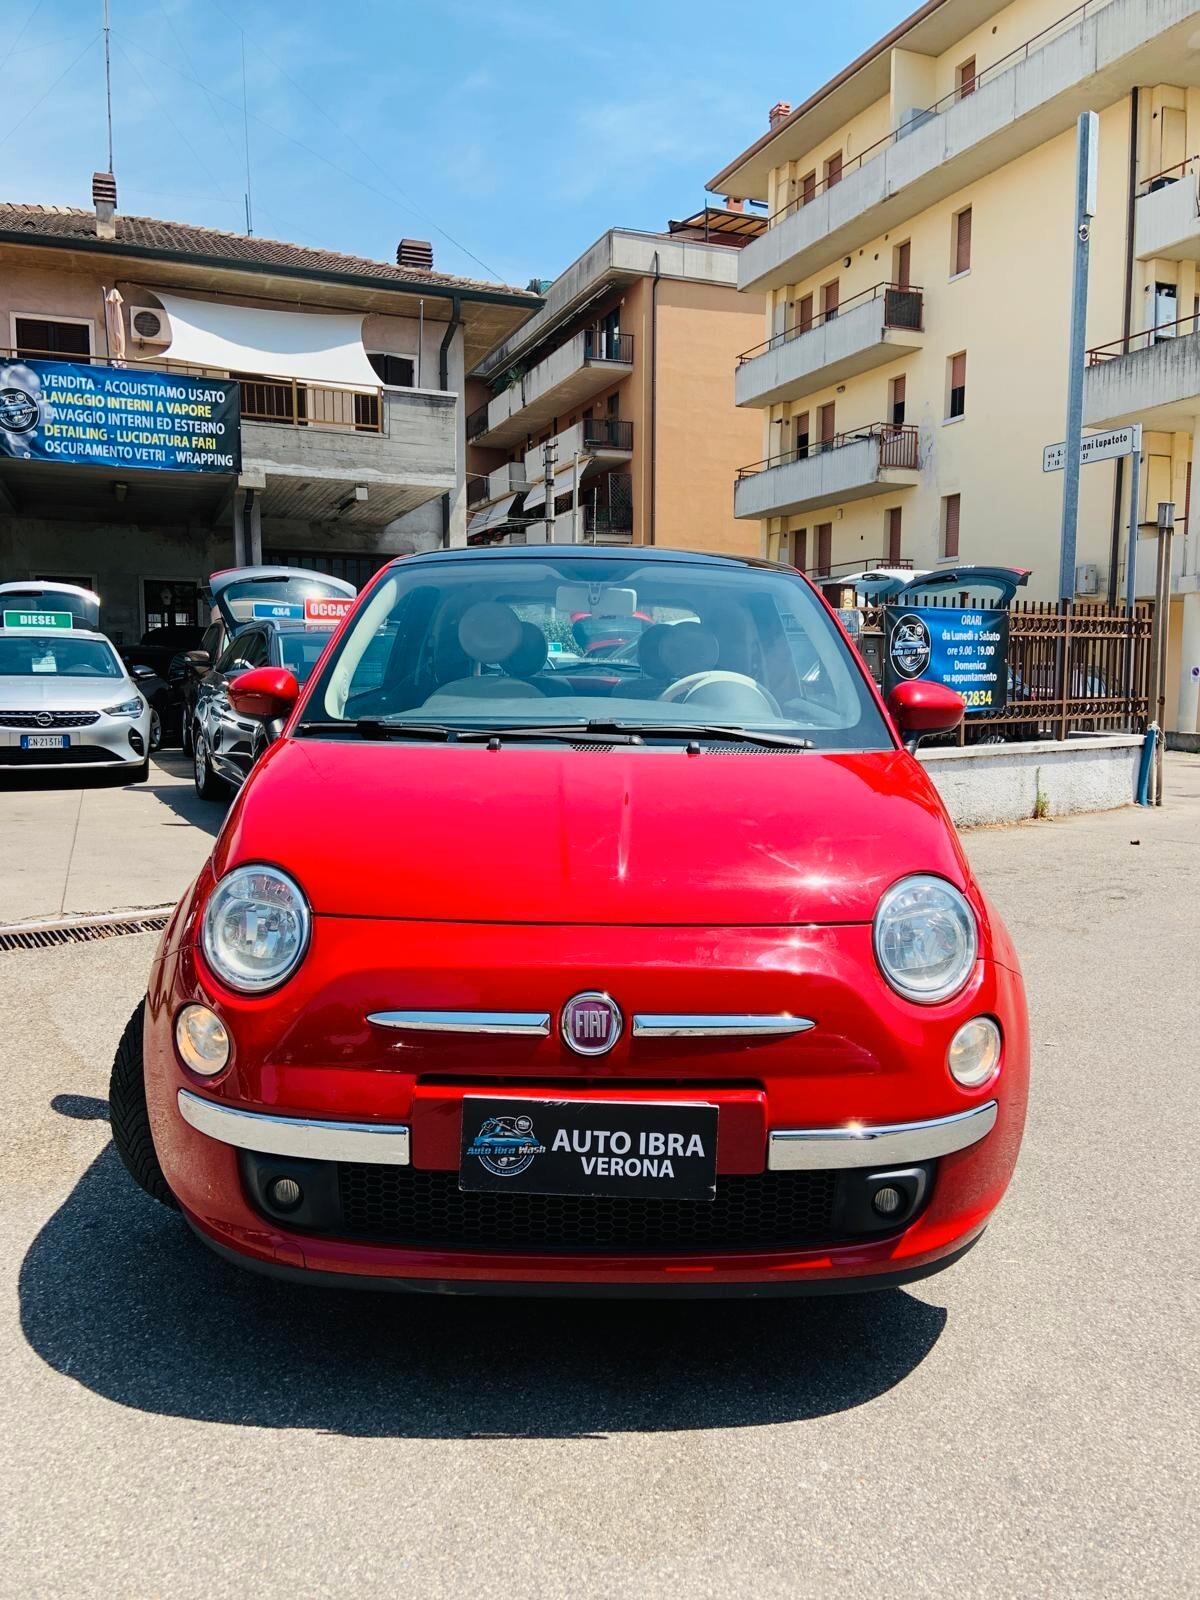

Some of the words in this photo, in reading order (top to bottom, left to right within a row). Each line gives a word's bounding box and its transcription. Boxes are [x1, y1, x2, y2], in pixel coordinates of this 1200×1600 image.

[42, 375, 95, 391] VENDITA
[104, 380, 186, 400] ACQUISTIAMO
[188, 389, 226, 403] USATO
[43, 391, 105, 408] LAVAGGIO
[107, 397, 153, 412] INTERNI
[156, 402, 164, 413] A
[166, 403, 212, 418] VAPORE
[44, 407, 106, 424] LAVAGGIO
[108, 414, 154, 429] INTERNI
[157, 417, 172, 431] ED
[174, 419, 225, 435] ESTERNO
[44, 424, 108, 441] DETAILING
[116, 432, 189, 448] LUCIDATURA
[192, 437, 216, 450] FARI
[45, 440, 133, 459] OSCURAMENTO
[134, 448, 166, 462] VETRI
[176, 451, 234, 467] WRAPPING
[272, 607, 291, 616] 4X4
[20, 615, 56, 625] DIESEL
[961, 615, 982, 626] ORARI
[942, 629, 951, 640] da
[974, 633, 979, 641] a
[979, 631, 1000, 642] Sabato
[947, 647, 958, 656] ore
[958, 646, 973, 656] 9.00
[977, 646, 995, 656] 19.00
[954, 660, 987, 671] Domenica
[943, 674, 951, 682] su
[951, 672, 998, 684] appuntamento
[957, 690, 993, 706] 62834
[575, 1010, 609, 1038] FIAT
[466, 1146, 492, 1155] Auto
[494, 1146, 516, 1154] Ibra
[518, 1145, 547, 1155] Wash
[551, 1128, 632, 1155] AUTO
[639, 1132, 705, 1158] IBRA
[581, 1156, 675, 1178] VERONA
